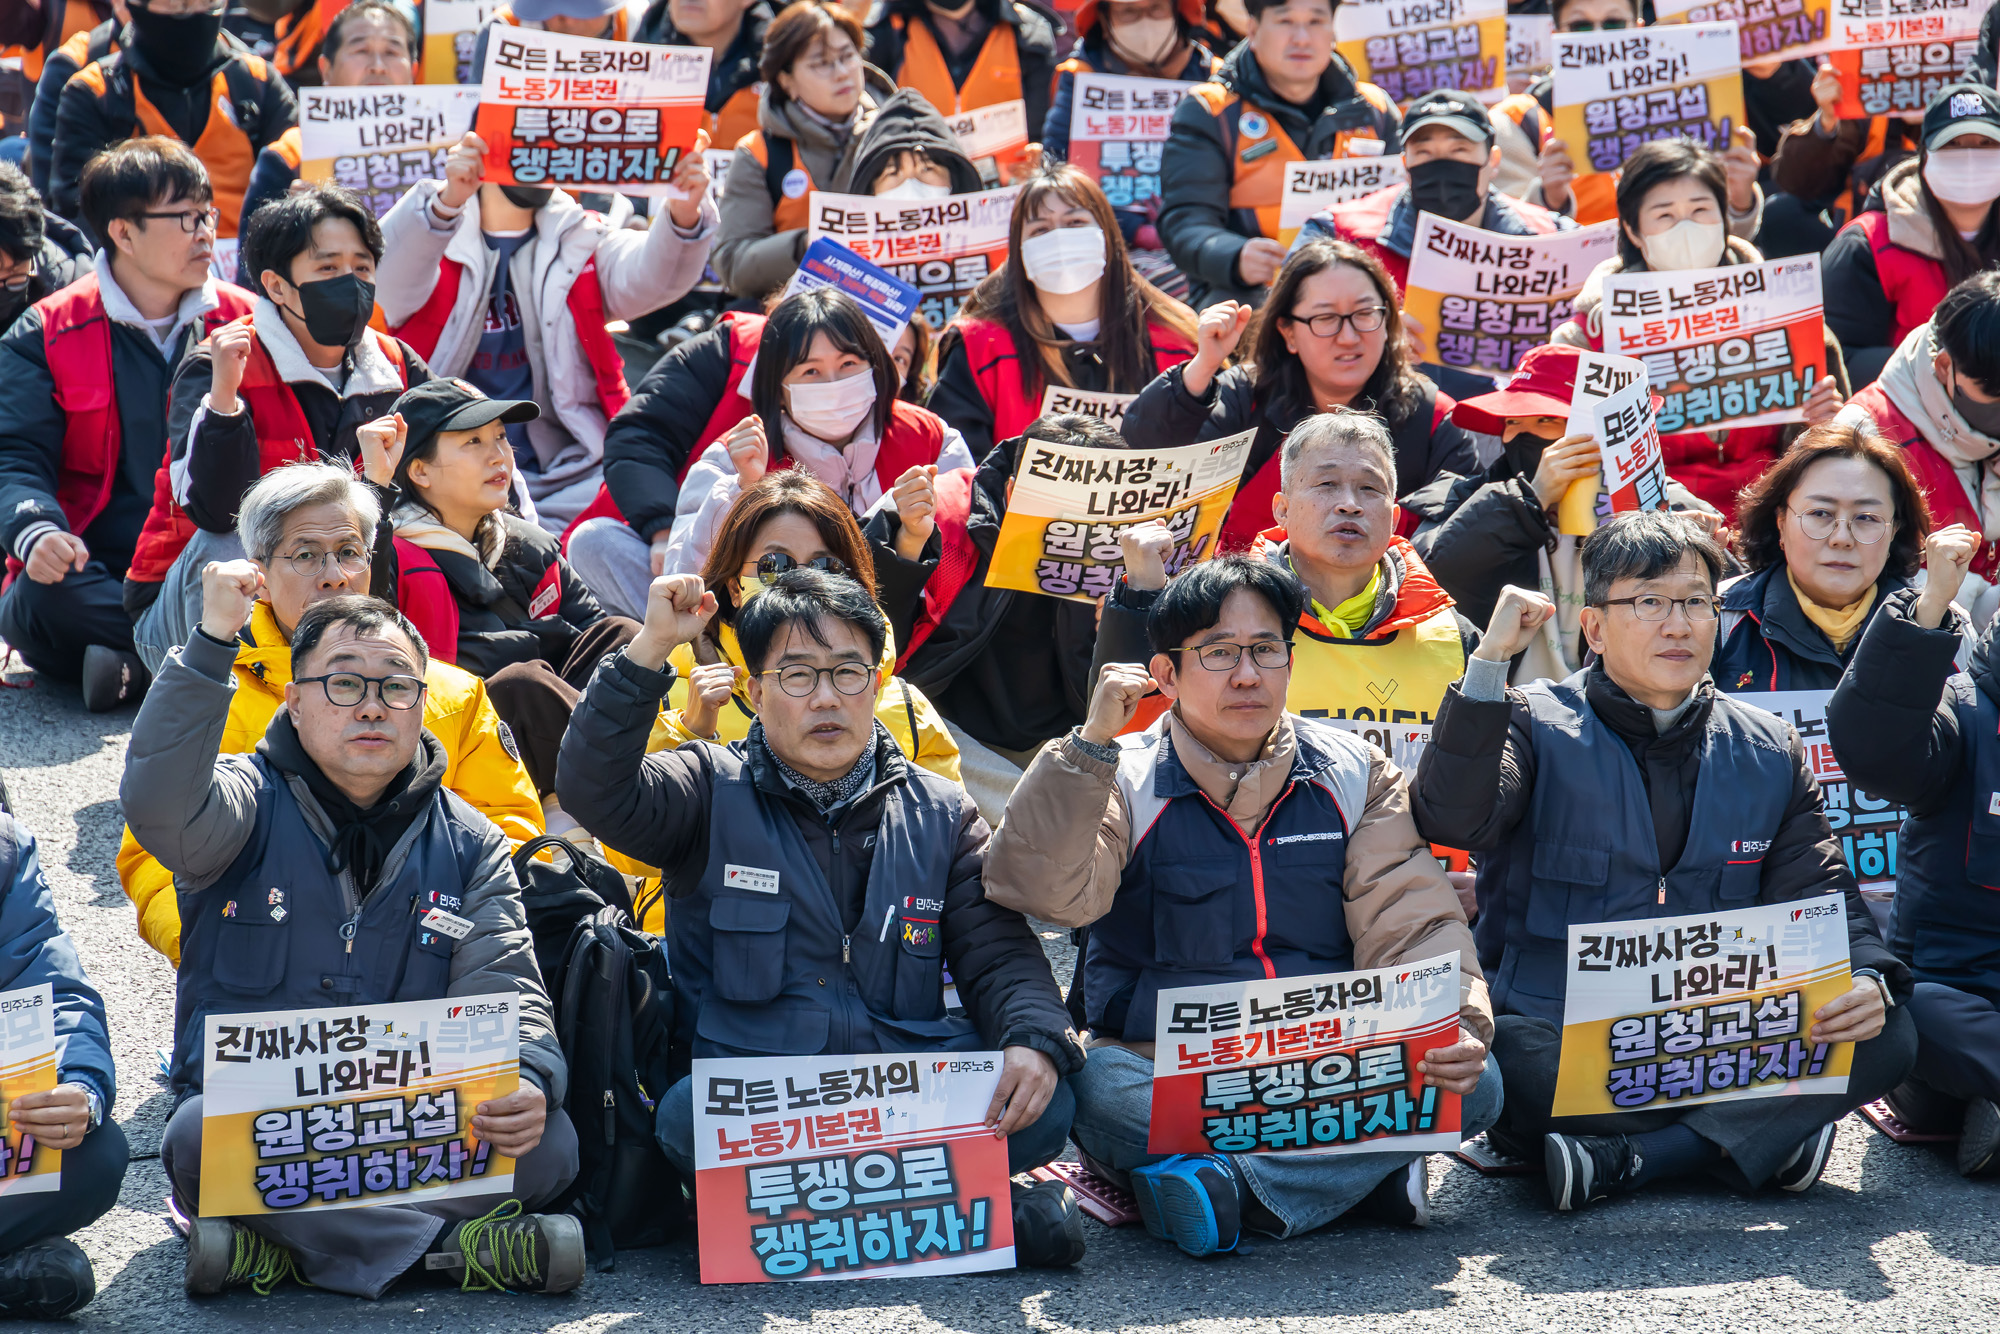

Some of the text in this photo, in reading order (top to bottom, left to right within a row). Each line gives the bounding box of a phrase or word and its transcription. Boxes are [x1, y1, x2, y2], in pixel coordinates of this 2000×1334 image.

[1388, 1, 1465, 28] 나와라!
[1845, 16, 1944, 44] 노동기본권
[495, 39, 547, 70] 모든
[553, 49, 651, 73] 노동자의
[1365, 23, 1481, 70] 원청교섭
[1560, 36, 1650, 69] 진짜사장
[498, 76, 617, 101] 노동기본권
[1609, 53, 1690, 91] 나와라!
[307, 94, 407, 122] 진짜사장
[1083, 86, 1124, 110] 모든
[1584, 83, 1709, 136] 원청교섭
[359, 112, 446, 147] 나와라!
[512, 107, 661, 144] 투쟁으로
[1087, 115, 1171, 135] 노동기본
[510, 147, 680, 183] 쟁취하자!
[1292, 165, 1383, 193] 진짜사장
[818, 200, 969, 234] 모든 노동자의
[849, 232, 942, 261] 동기본권
[1427, 224, 1535, 270] 진짜사장
[1475, 264, 1569, 296] 나와라!
[1611, 268, 1766, 317] 모든 노동자의
[1619, 305, 1740, 351] 노동기본권
[1641, 328, 1792, 391] 투쟁으로
[1222, 437, 1250, 453] 민주노총
[1604, 406, 1640, 447] 모든
[1028, 449, 1158, 485] 진짜사장
[1087, 473, 1193, 516] 나와라!
[1044, 503, 1200, 561] 원청섭
[1805, 903, 1838, 920] 민주노총
[1577, 921, 1722, 972] 진짜사장
[1413, 962, 1452, 981] 민주노총
[1651, 945, 1778, 1003] 나와라!
[1, 995, 43, 1013] 민주노총
[465, 1002, 509, 1017] 민주노총
[1168, 975, 1383, 1034] 모든 노동자의
[215, 1015, 371, 1063] 진짜사장
[1178, 1017, 1343, 1070] 노동기본권
[1609, 991, 1801, 1064] 원청교섭
[295, 1041, 432, 1097] 나와라!
[950, 1060, 994, 1073] 민주노총
[1202, 1042, 1408, 1113] 투쟁으로
[1606, 1038, 1830, 1108] 쟁취하자!
[705, 1060, 920, 1117] 모든 노동자의
[253, 1088, 459, 1159] 원청교섭
[717, 1107, 882, 1160] 노동기본권
[1201, 1084, 1440, 1153] 쟁취하자!
[253, 1138, 492, 1208] 쟁취하자!
[746, 1143, 956, 1219] 투쟁으로
[751, 1196, 990, 1278] 쟁취하자!
